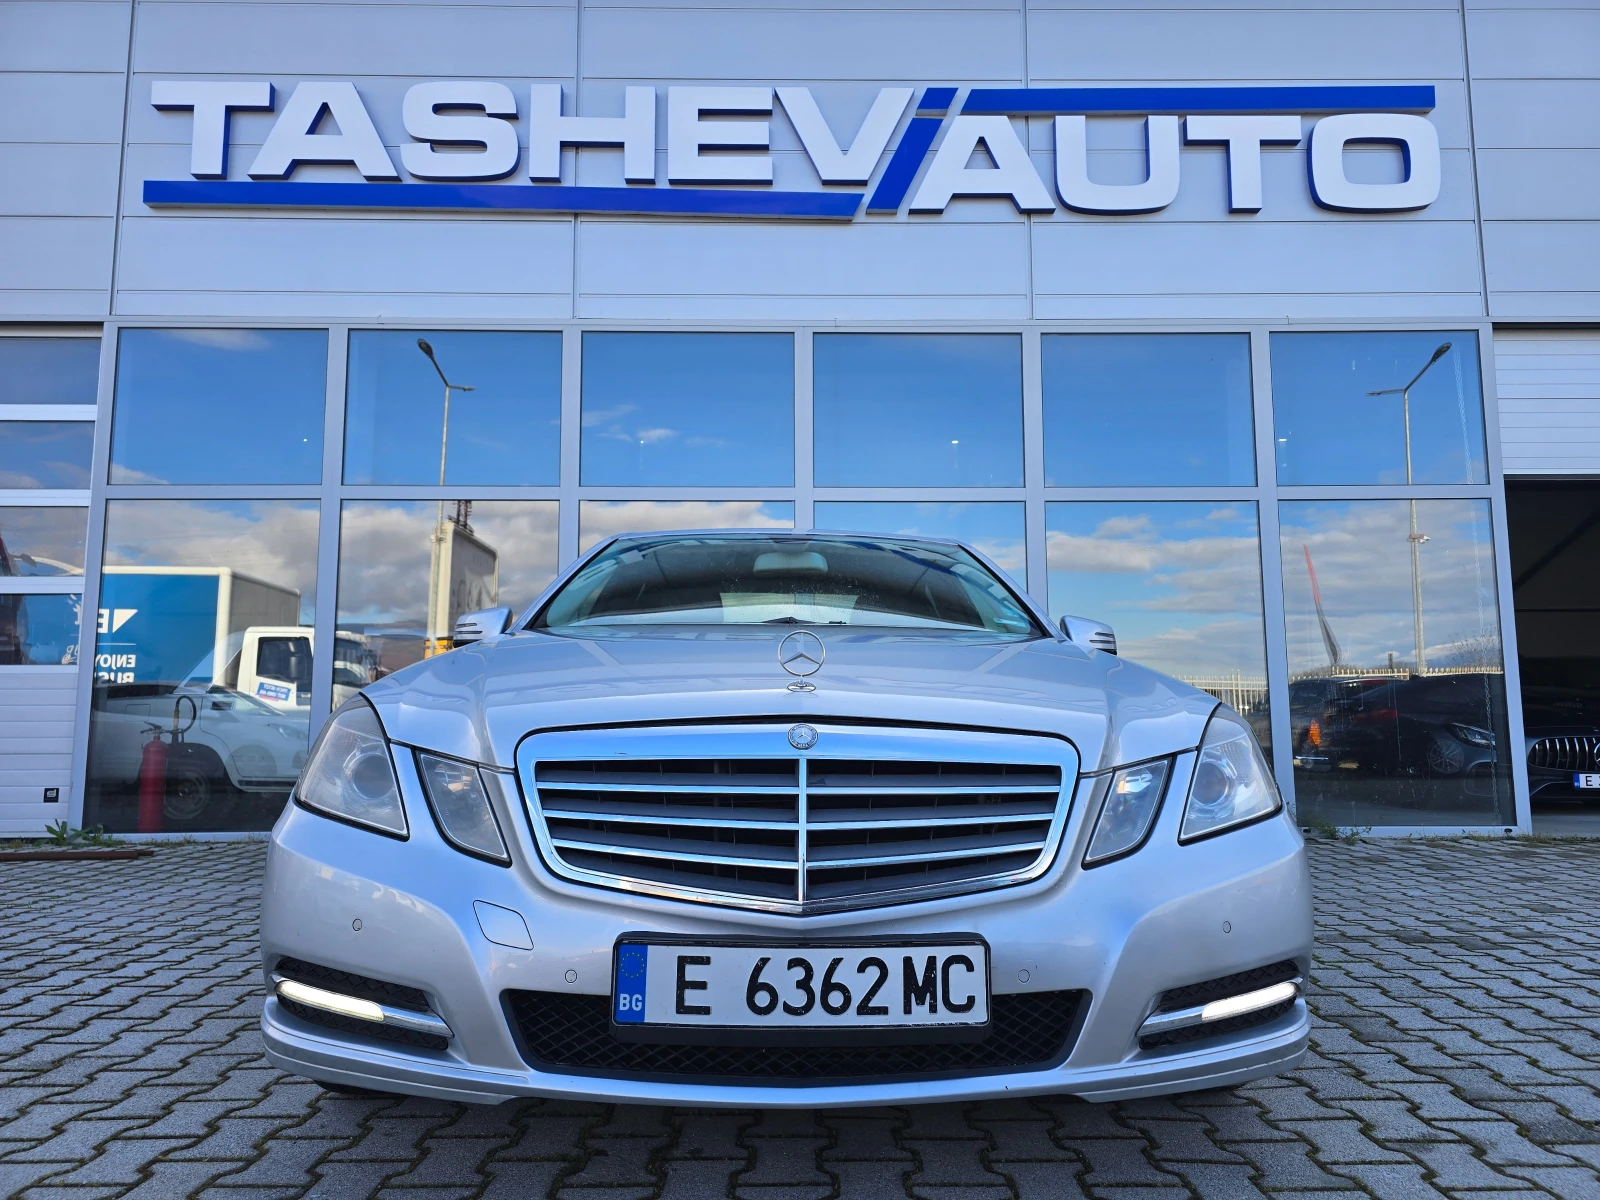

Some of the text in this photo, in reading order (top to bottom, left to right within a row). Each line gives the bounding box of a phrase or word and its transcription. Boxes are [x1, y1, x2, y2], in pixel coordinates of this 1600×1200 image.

[151, 80, 1441, 216] TASHEV AUTO
[619, 953, 976, 1017] BG E 6362 MC
